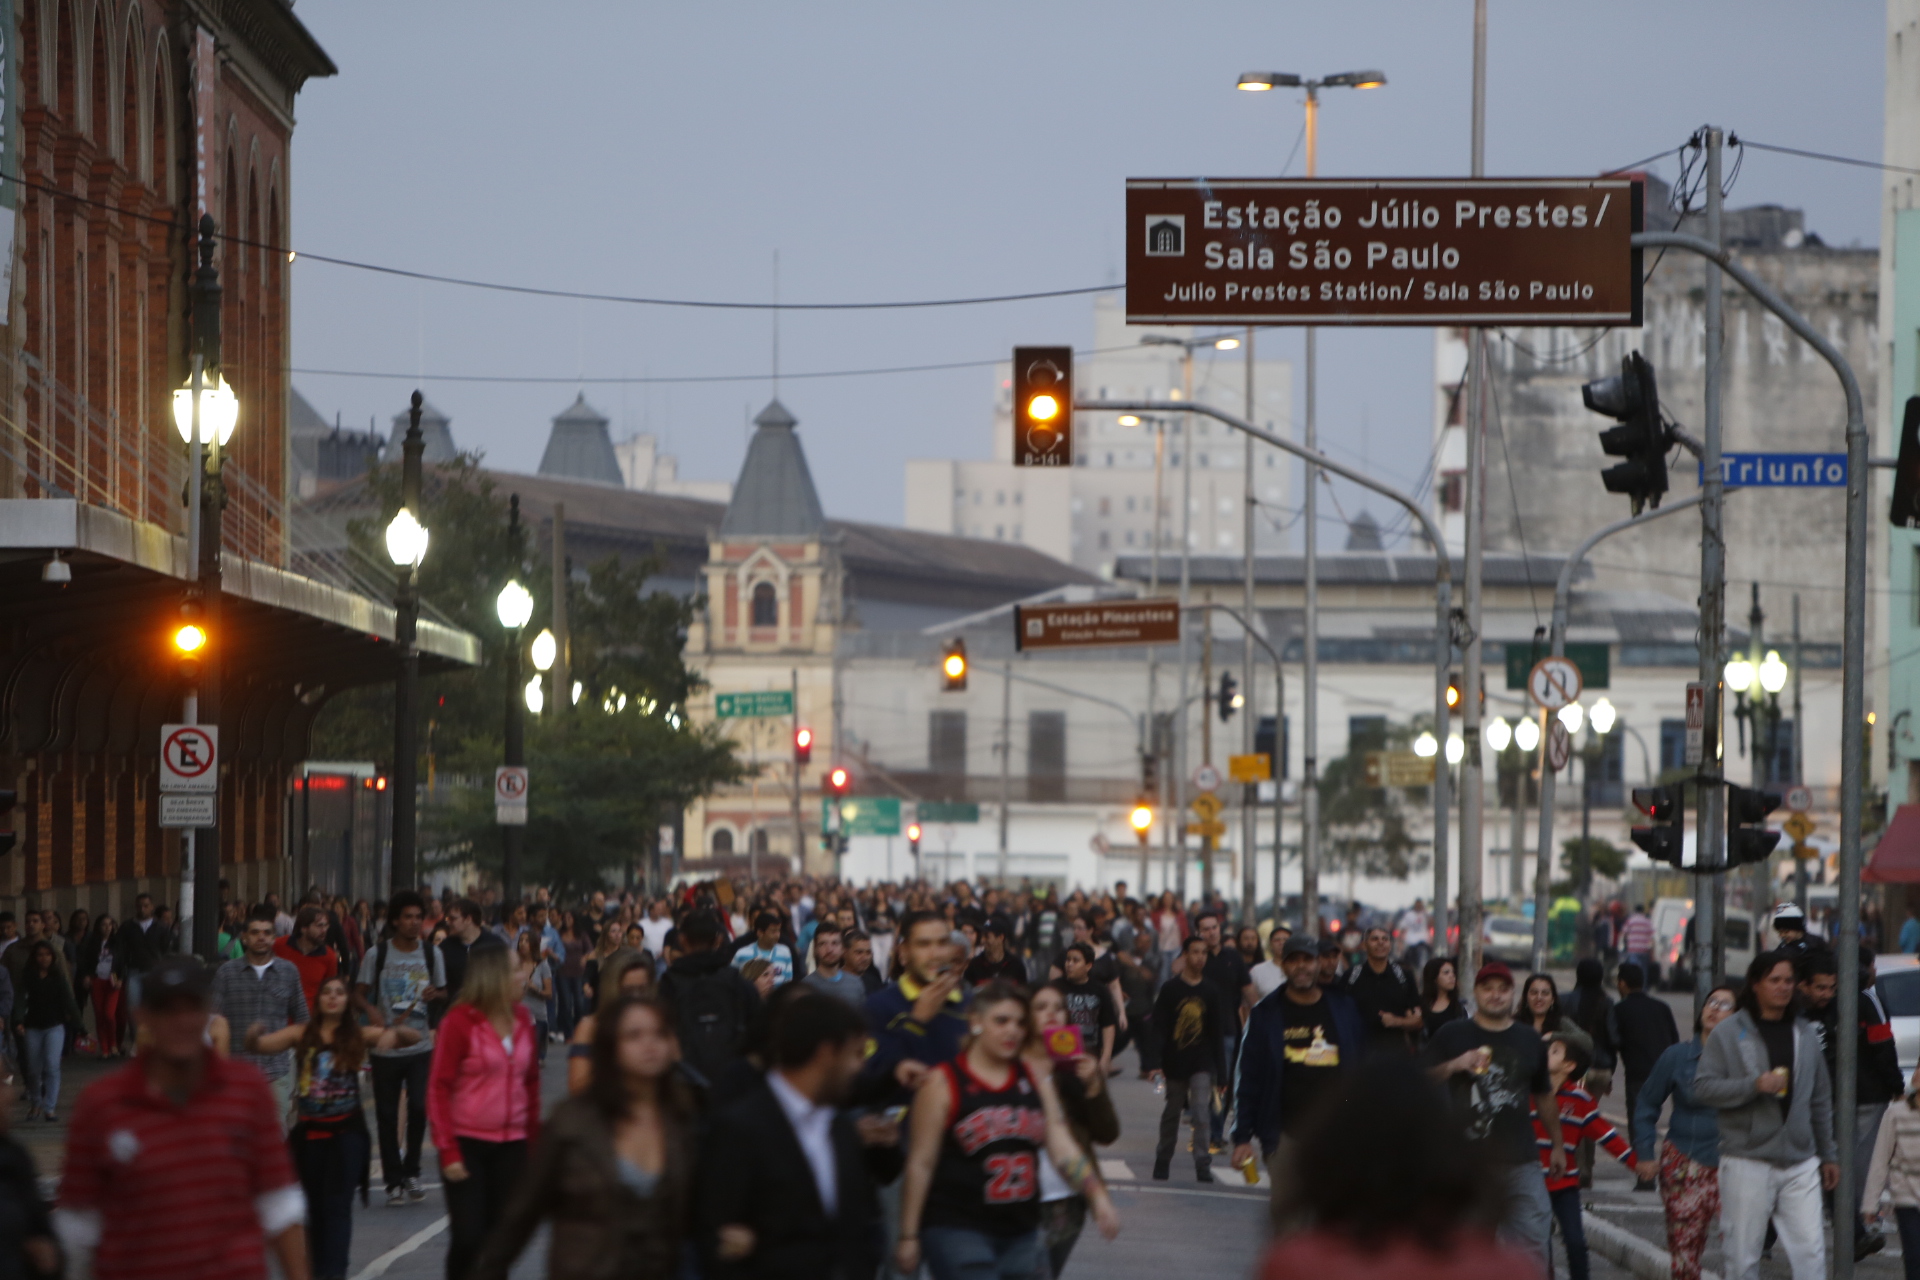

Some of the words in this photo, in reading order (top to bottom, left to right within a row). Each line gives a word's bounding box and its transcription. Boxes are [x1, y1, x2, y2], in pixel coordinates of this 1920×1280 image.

[1203, 199, 1342, 235] Estação
[1358, 198, 1440, 229] Júlio
[1455, 193, 1611, 229] Prestes/
[1204, 241, 1274, 270] Sala
[1288, 239, 1351, 270] São
[1367, 241, 1460, 270] Paulo
[1225, 281, 1310, 301] Prestes
[1320, 277, 1414, 301] Station/
[1423, 281, 1469, 301] Sala
[1479, 279, 1520, 301] São
[1529, 280, 1594, 301] Paulo
[1720, 457, 1843, 483] Triunfo
[1047, 611, 1099, 627] Estação
[1102, 609, 1175, 624] Pinacoteca
[984, 1152, 1037, 1203] 23
